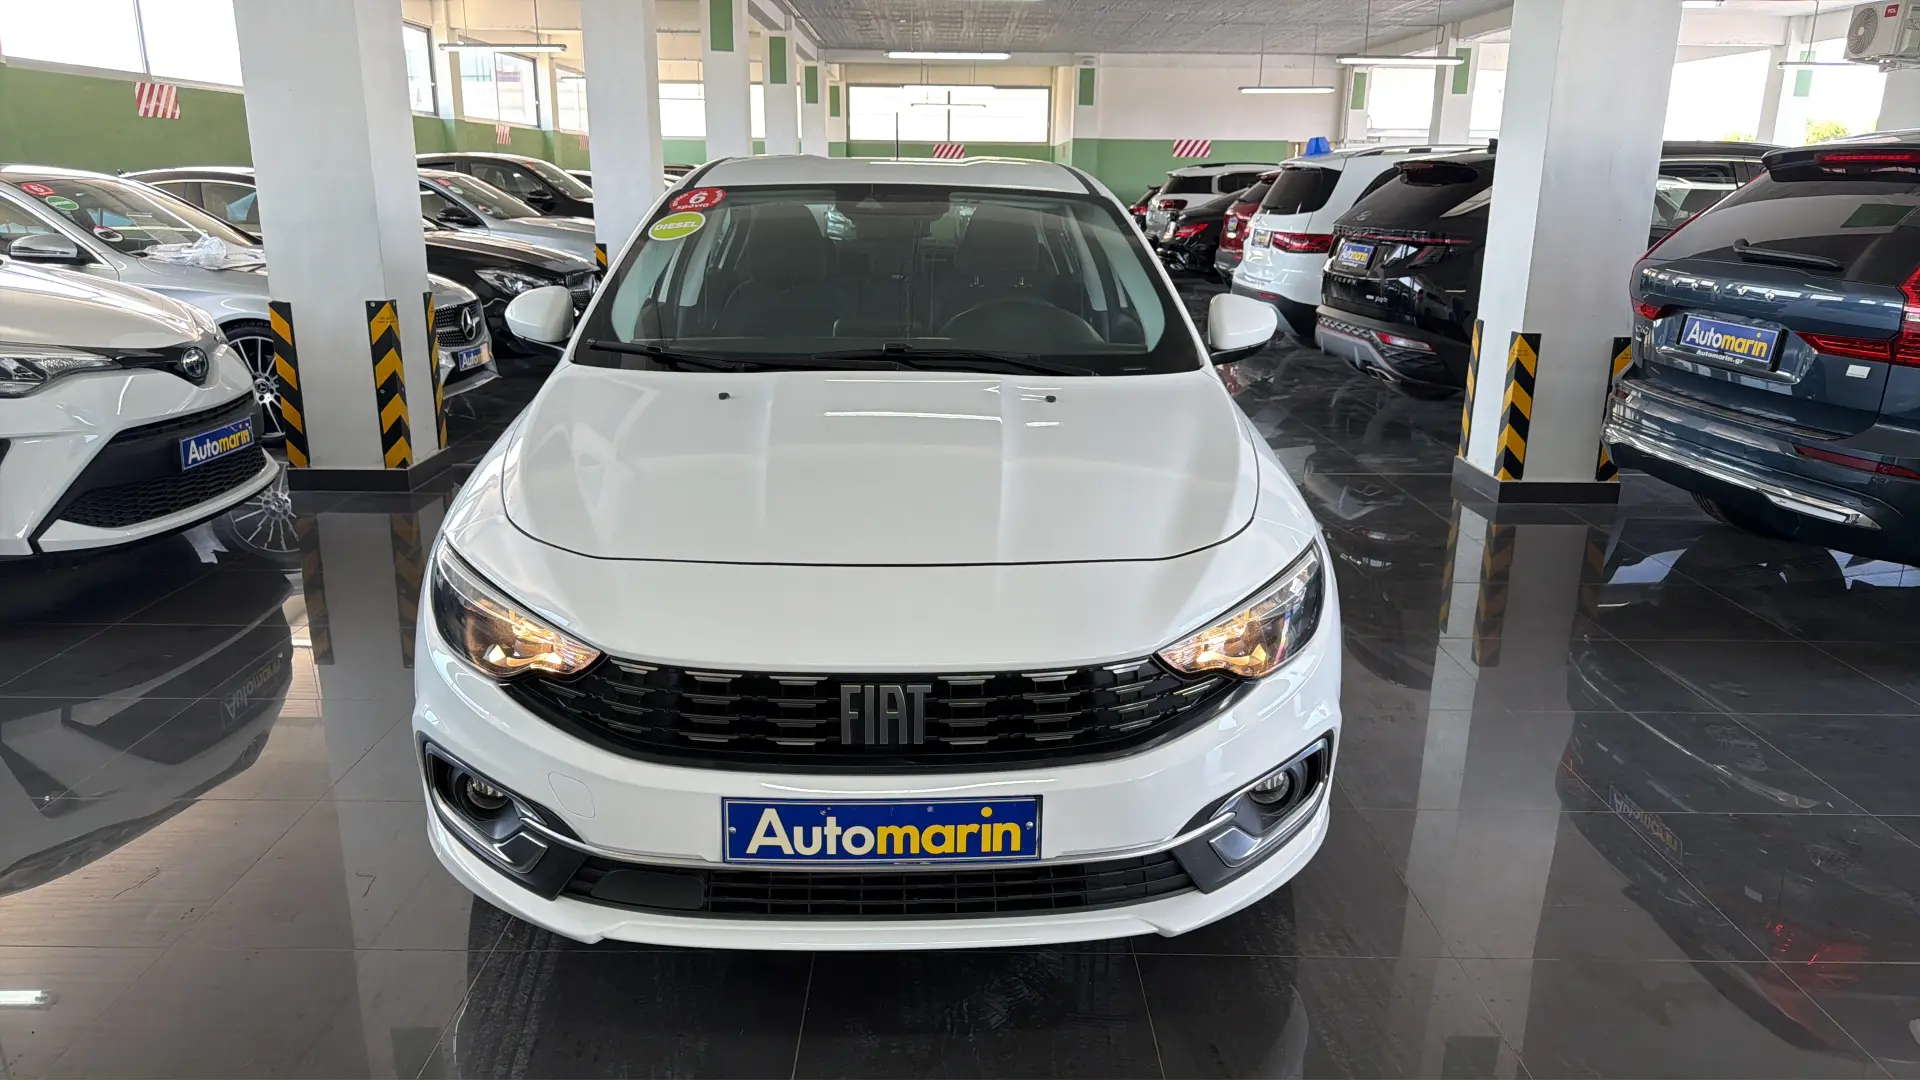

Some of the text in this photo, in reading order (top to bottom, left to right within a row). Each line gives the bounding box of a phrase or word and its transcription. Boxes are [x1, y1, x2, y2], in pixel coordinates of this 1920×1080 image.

[689, 190, 708, 204] 6
[654, 221, 698, 231] DIESEL
[1686, 320, 1768, 358] Automarin
[1696, 349, 1745, 365] Automarin.gr
[188, 424, 251, 465] Automarin
[840, 683, 932, 745] FIAT
[746, 806, 1022, 856] Automarin
